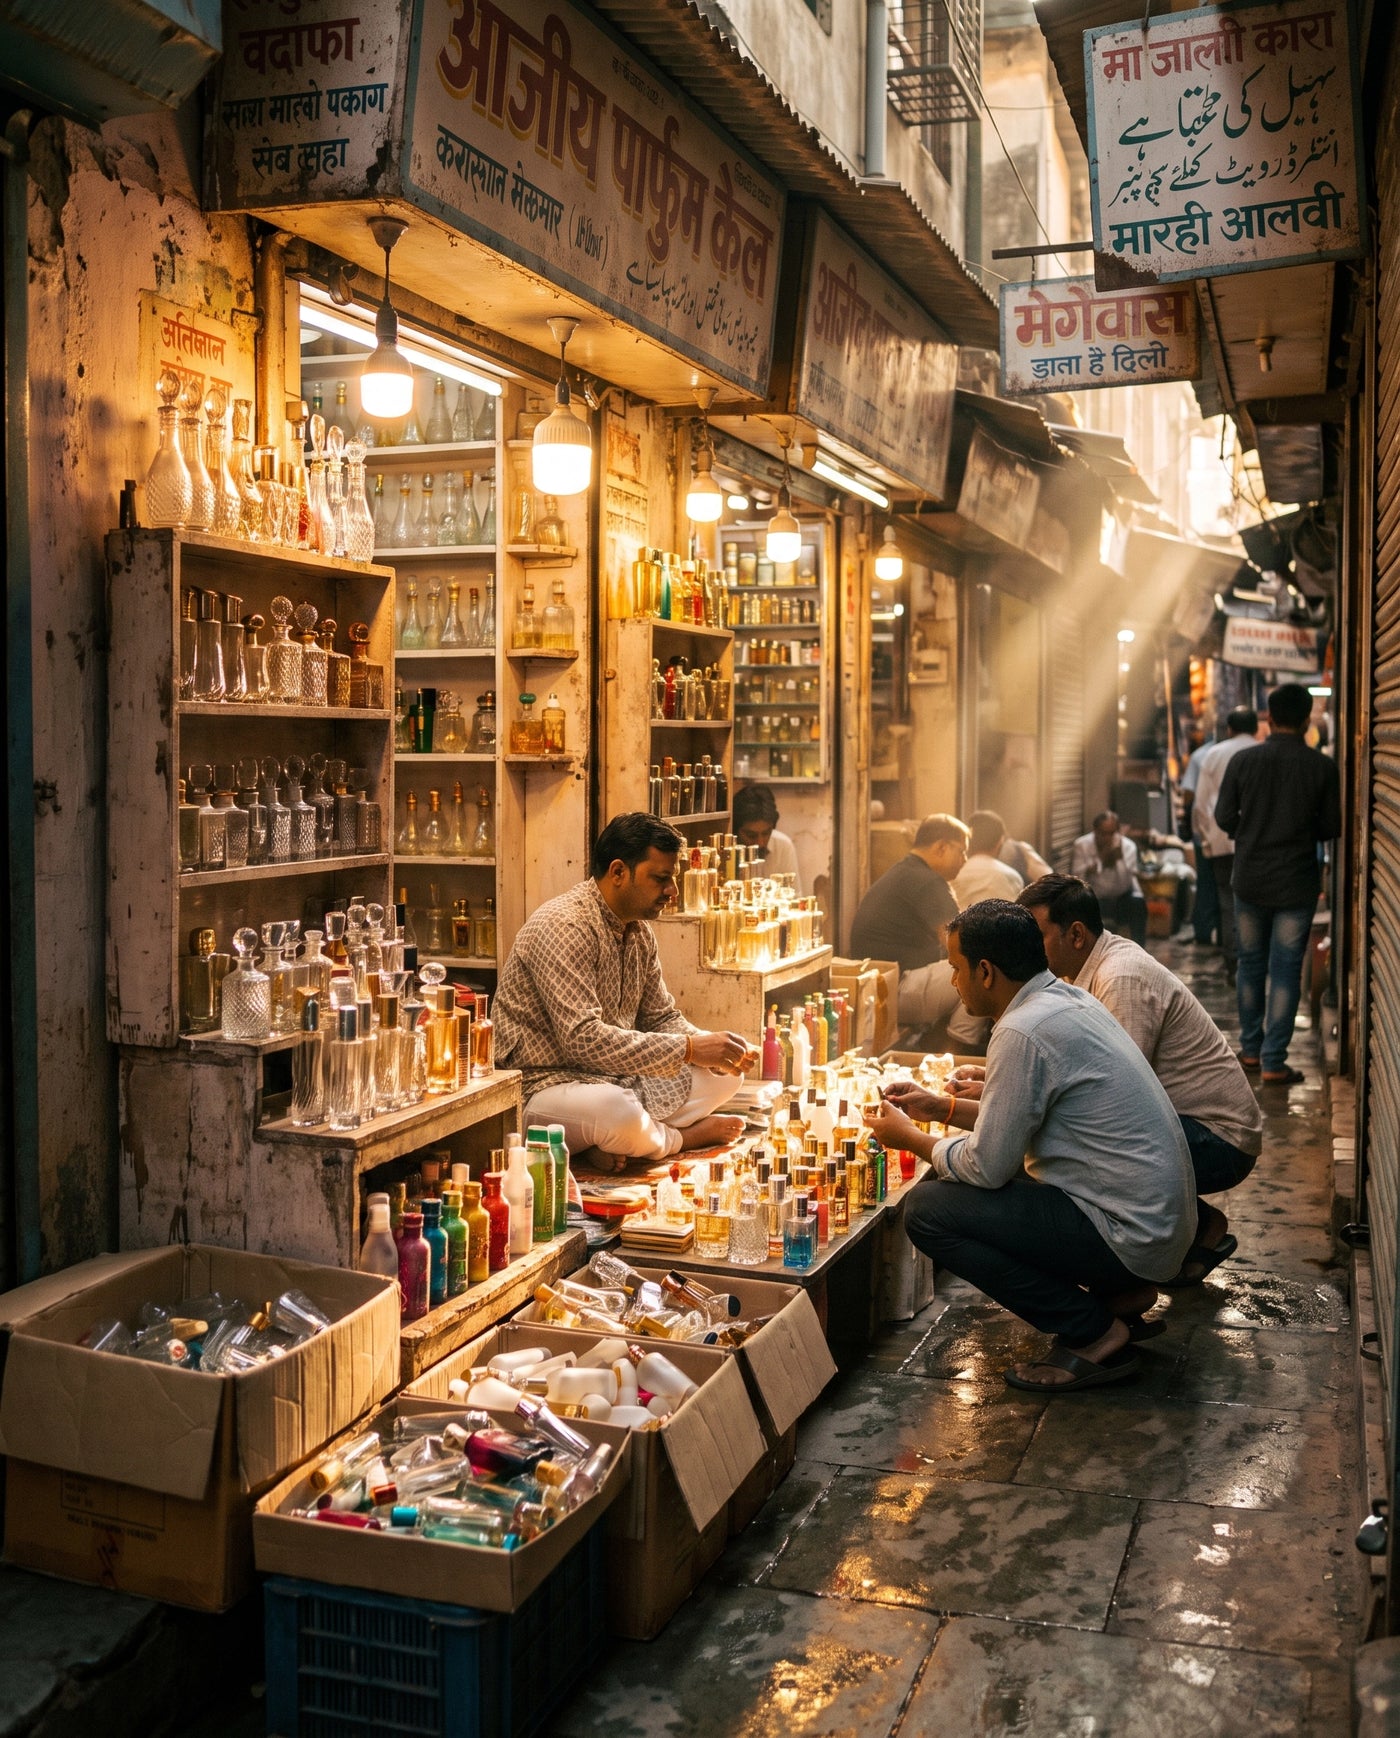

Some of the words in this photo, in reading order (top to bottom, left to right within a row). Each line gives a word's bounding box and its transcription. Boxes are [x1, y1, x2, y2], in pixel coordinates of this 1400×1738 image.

[1102, 46, 1143, 82] मा
[1252, 11, 1336, 56] कारा
[1109, 201, 1213, 255] मारही
[1220, 180, 1345, 242] आलवी
[1031, 355, 1082, 379] डाता
[1088, 347, 1106, 376] है
